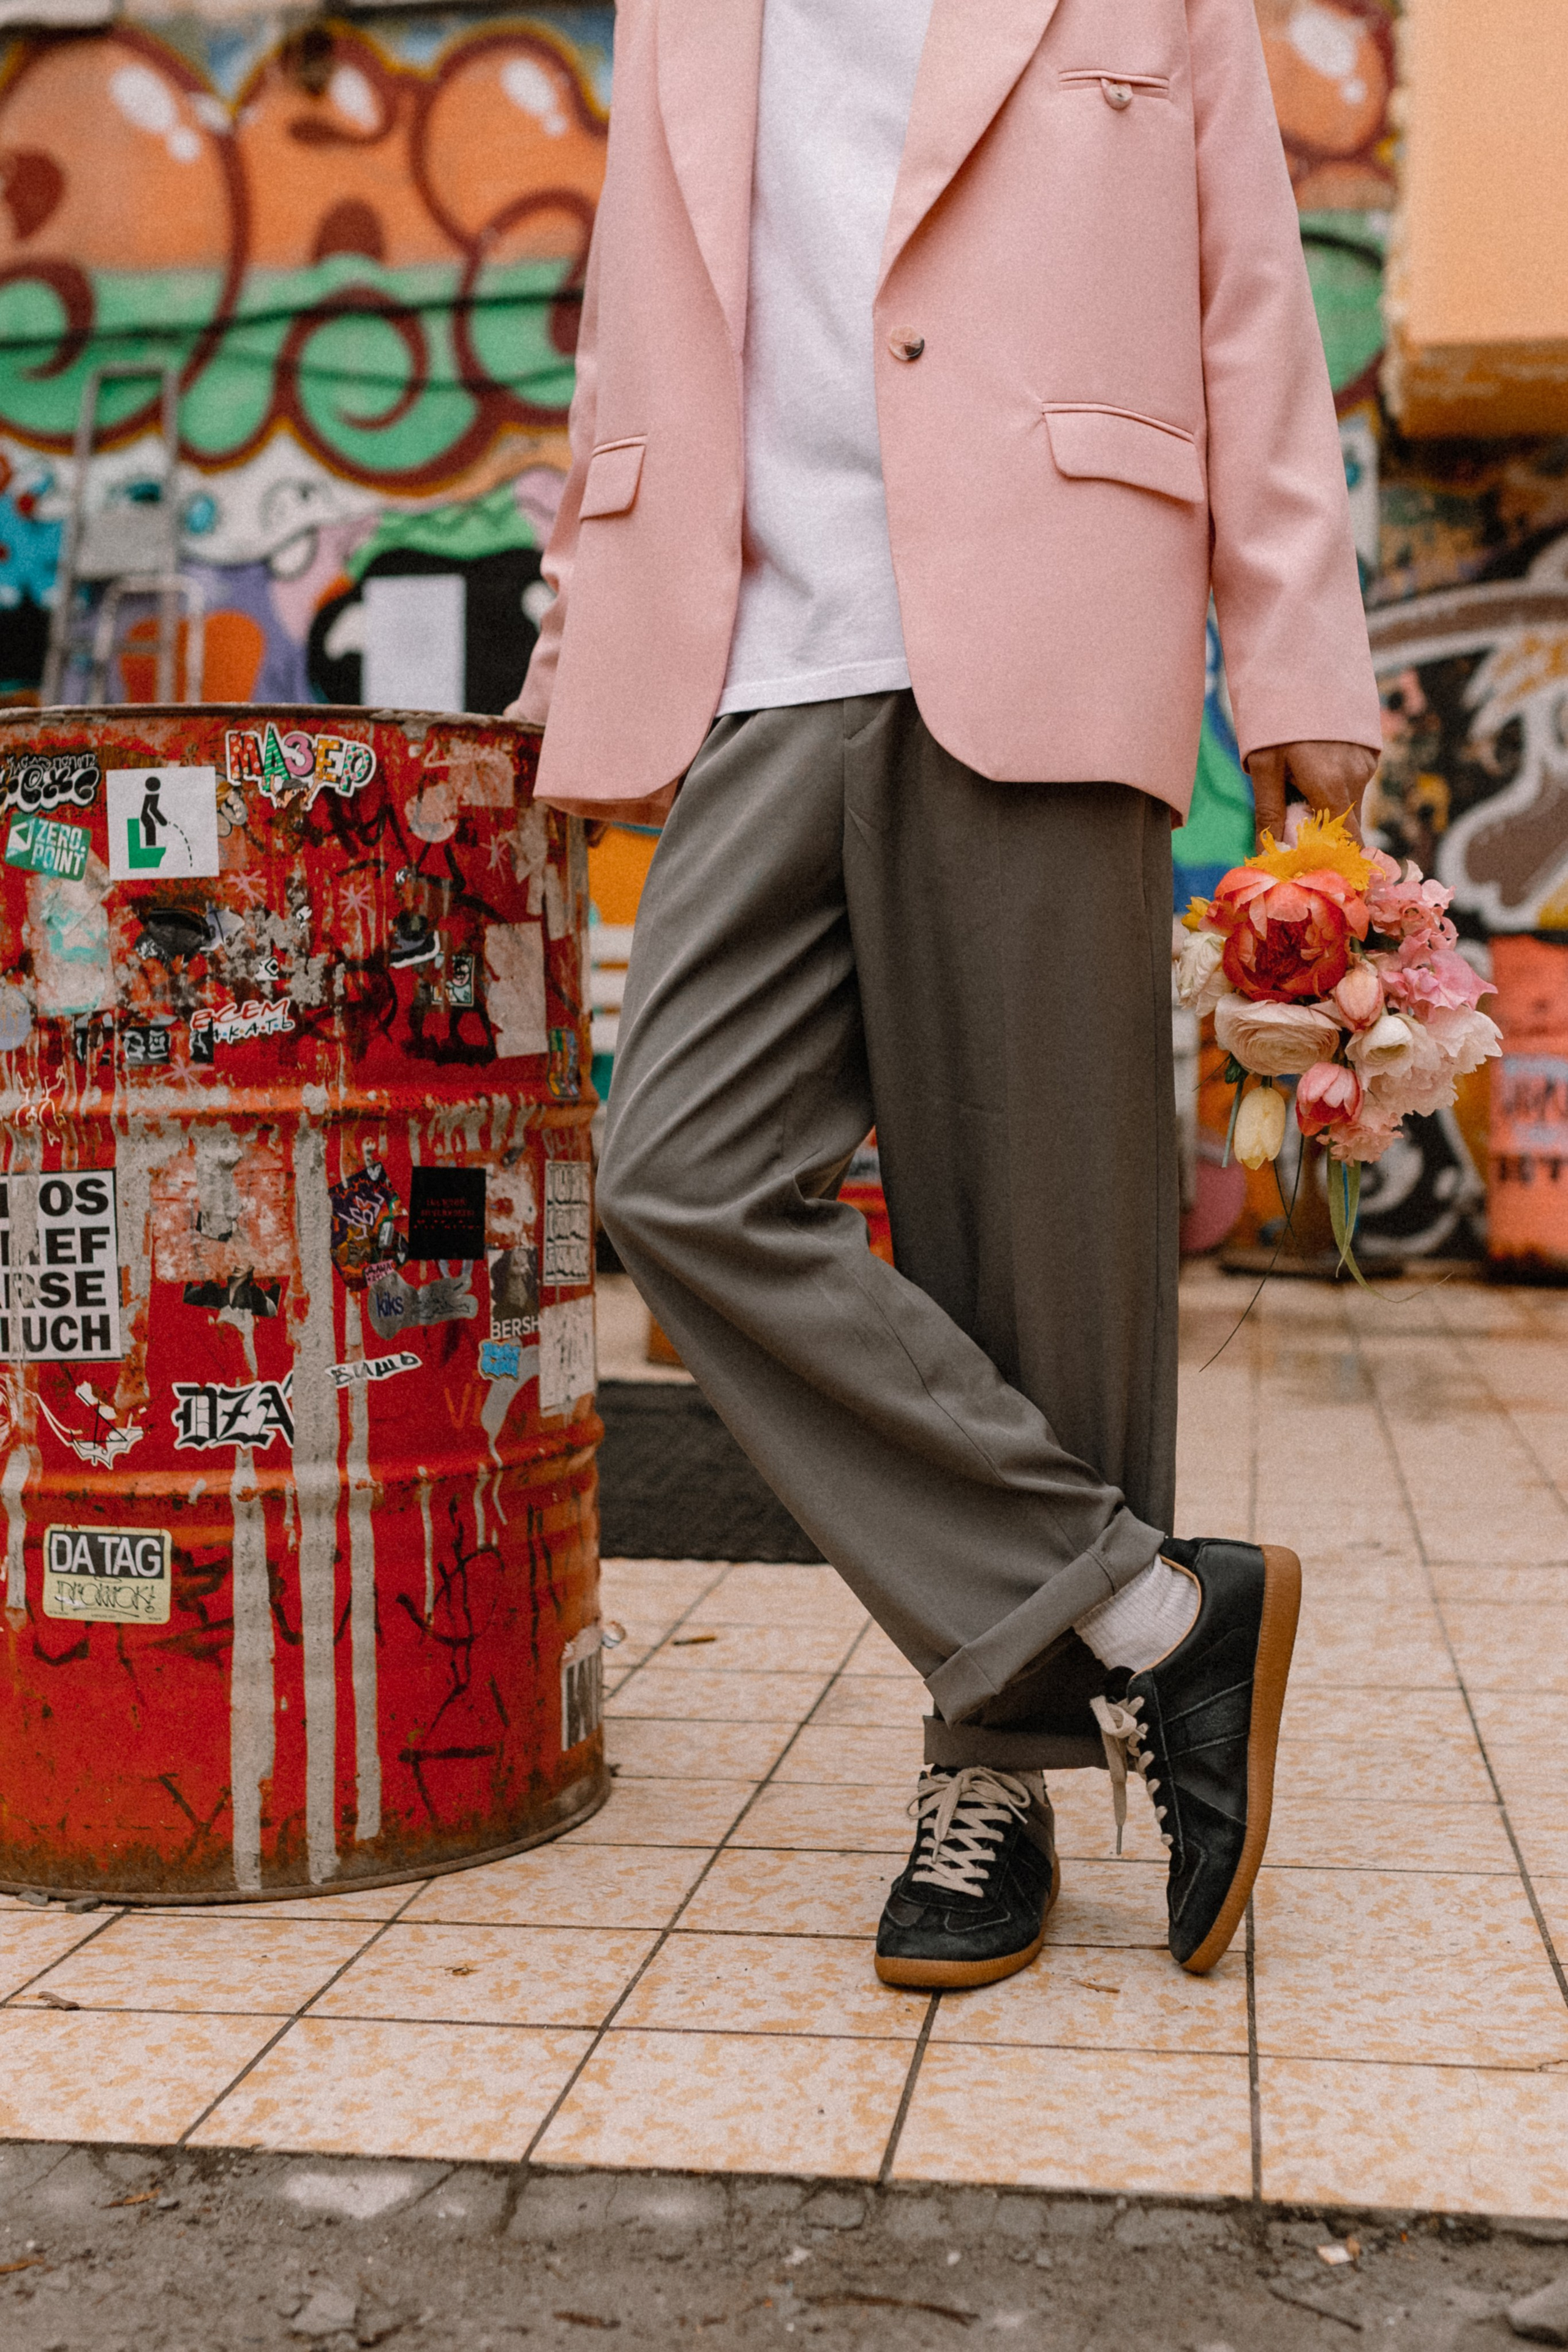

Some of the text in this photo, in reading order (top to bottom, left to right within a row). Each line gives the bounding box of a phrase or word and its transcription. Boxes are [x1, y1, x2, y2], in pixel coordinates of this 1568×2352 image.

[31, 843, 85, 876] POINT
[51, 1533, 96, 1574] DA
[97, 1536, 161, 1577] TAG
